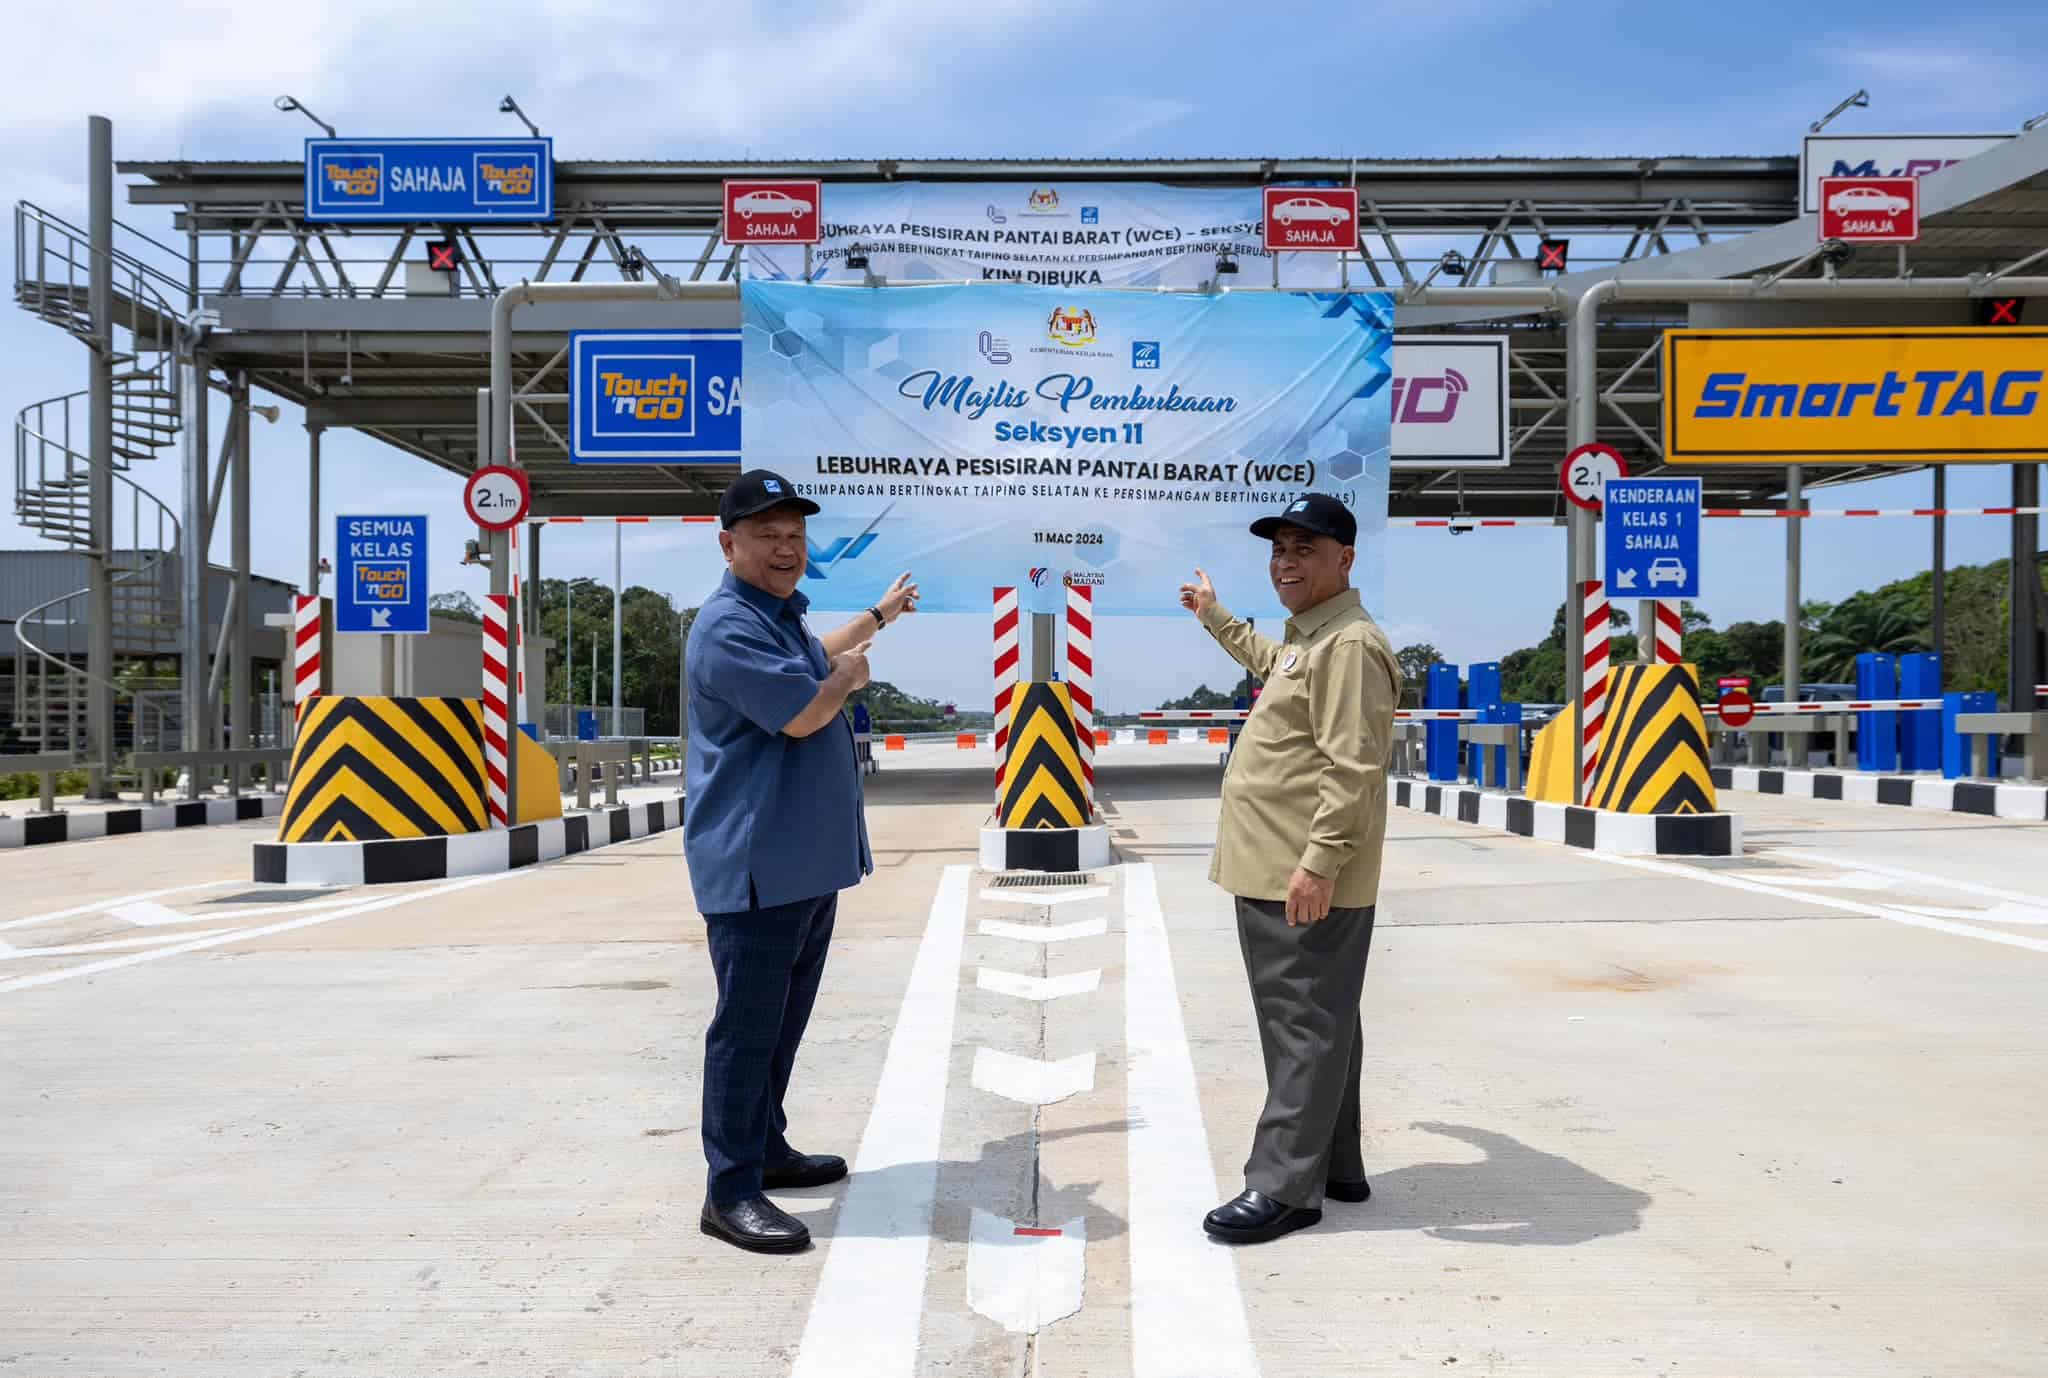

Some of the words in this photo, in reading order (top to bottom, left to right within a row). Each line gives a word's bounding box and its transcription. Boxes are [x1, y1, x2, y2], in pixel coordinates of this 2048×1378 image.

[325, 164, 379, 180] Touch
[390, 166, 466, 192] SAHAJA
[480, 163, 534, 179] Touch
[746, 223, 798, 236] SAHAJA
[901, 223, 988, 243] PESISIRAN
[994, 230, 1058, 245] PANTAI
[1062, 230, 1121, 245] BARAT
[1126, 226, 1181, 246] (WCE)
[1841, 219, 1895, 233] SAHAJA
[1285, 229, 1335, 243] SAHAJA
[898, 243, 965, 257] BERTINGKAT
[968, 249, 1010, 261] TAIPING
[1012, 253, 1059, 263] SELATAN
[1027, 269, 1103, 286] DIBUKA
[1135, 359, 1156, 368] WCE
[600, 373, 688, 396] Touch
[898, 370, 1029, 420] Majlis
[1035, 373, 1238, 413] Pembukaan
[1692, 370, 2044, 418] SmartTAG
[995, 420, 1115, 449] Seksyen
[1122, 423, 1143, 445] 11
[817, 455, 950, 476] LEBUHRAYA
[956, 457, 1072, 476] PESISIRAN
[1079, 458, 1158, 480] PANTAI
[1164, 463, 1238, 482] BARAT
[1244, 460, 1315, 487] (WCE)
[792, 483, 884, 496] RSIMPANGAN
[890, 484, 969, 497] BERTINGKAT
[974, 484, 1026, 497] TAIPING
[1032, 484, 1089, 497] SELATAN
[1094, 486, 1109, 498] KE
[1114, 487, 1210, 502] PERSIMPANGAN
[1215, 490, 1294, 504] BERTINGKAT
[1609, 487, 1695, 504] KENDERAAN
[1622, 511, 1668, 527] KELAS
[1676, 511, 1682, 526] 1
[349, 520, 415, 537] SEMUA
[1034, 532, 1043, 544] 11
[1047, 532, 1073, 544] MAC
[1075, 532, 1103, 545] 2024
[1625, 534, 1680, 550] SAHAJA
[350, 541, 413, 558] KELAS
[357, 566, 406, 582] Touch
